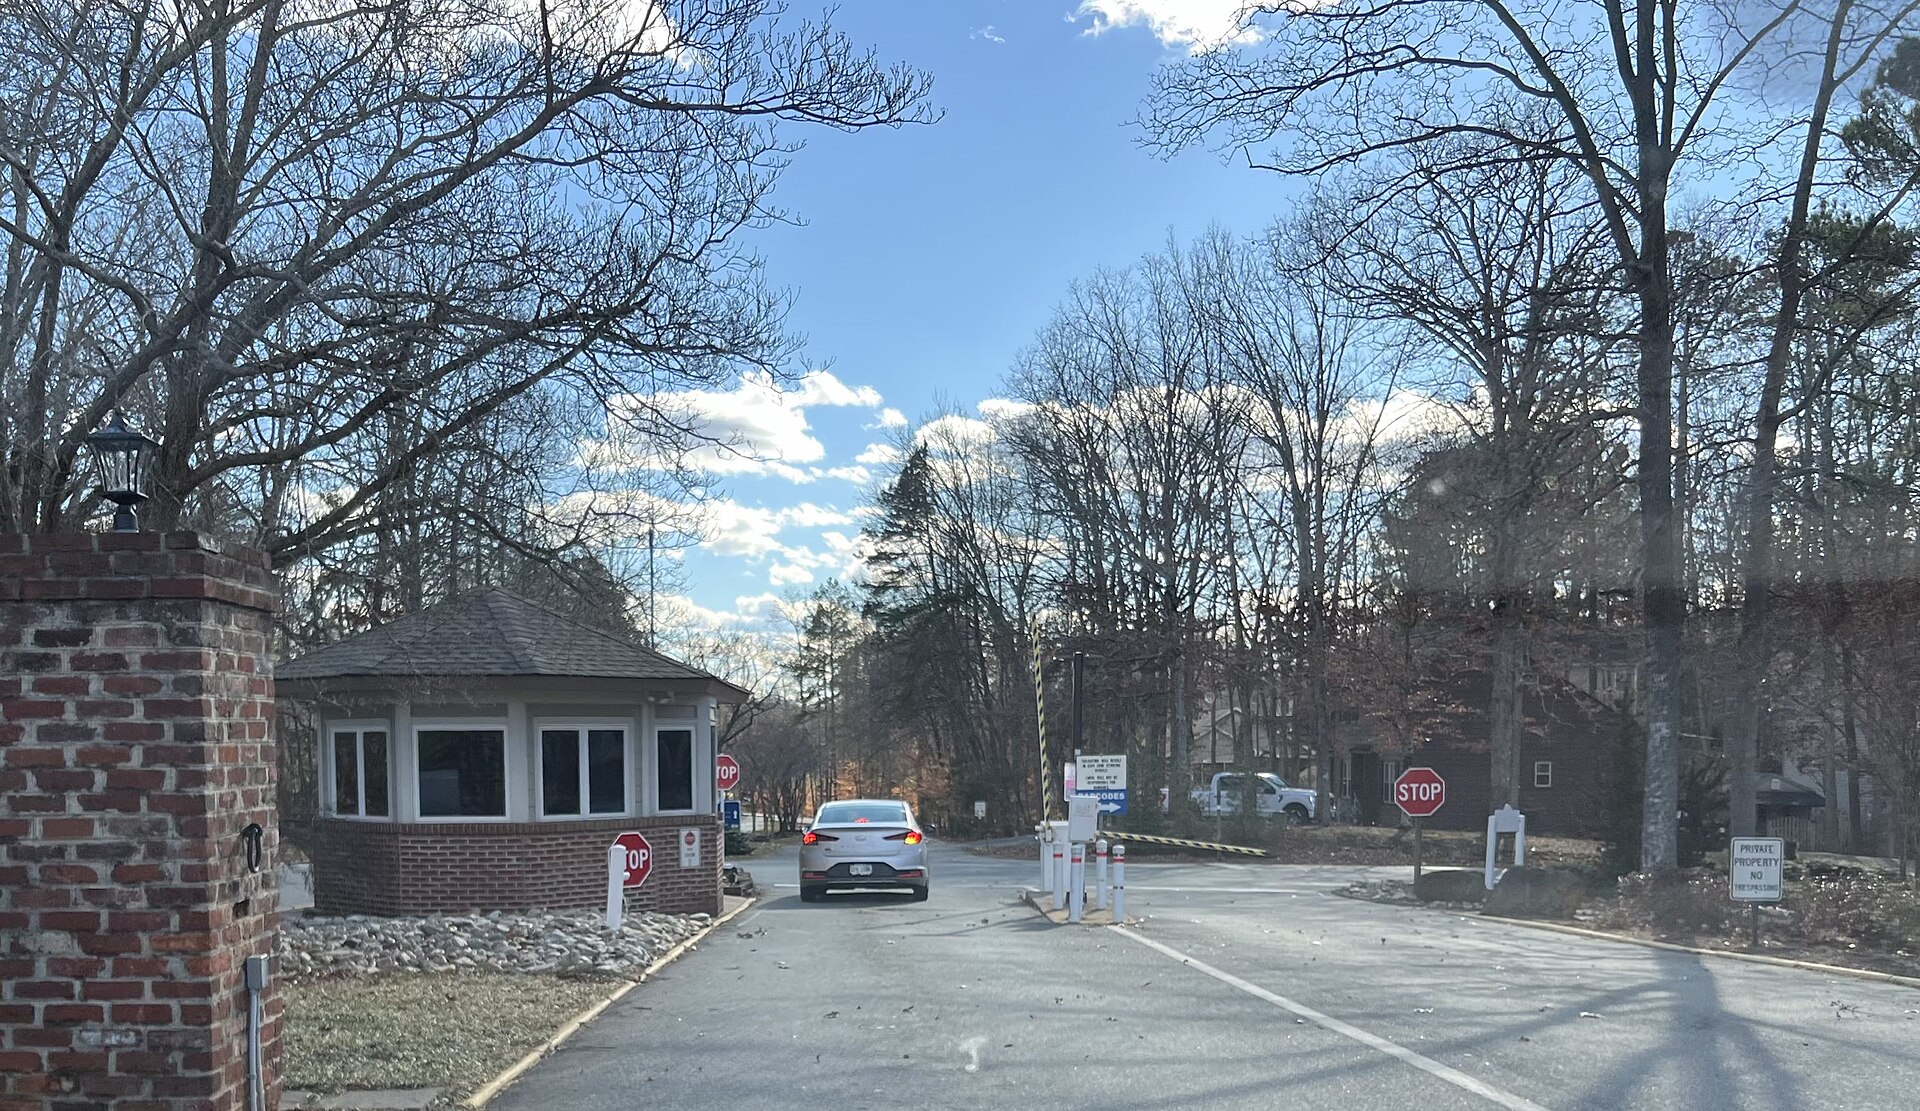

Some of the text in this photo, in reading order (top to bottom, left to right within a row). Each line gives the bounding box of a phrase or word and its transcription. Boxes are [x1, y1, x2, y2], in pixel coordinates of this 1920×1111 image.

[716, 766, 737, 780] TOP
[1398, 783, 1441, 801] STOP
[1740, 844, 1774, 854] PRIVATE
[1734, 857, 1780, 867] PROPERTY
[1750, 871, 1763, 880] NO
